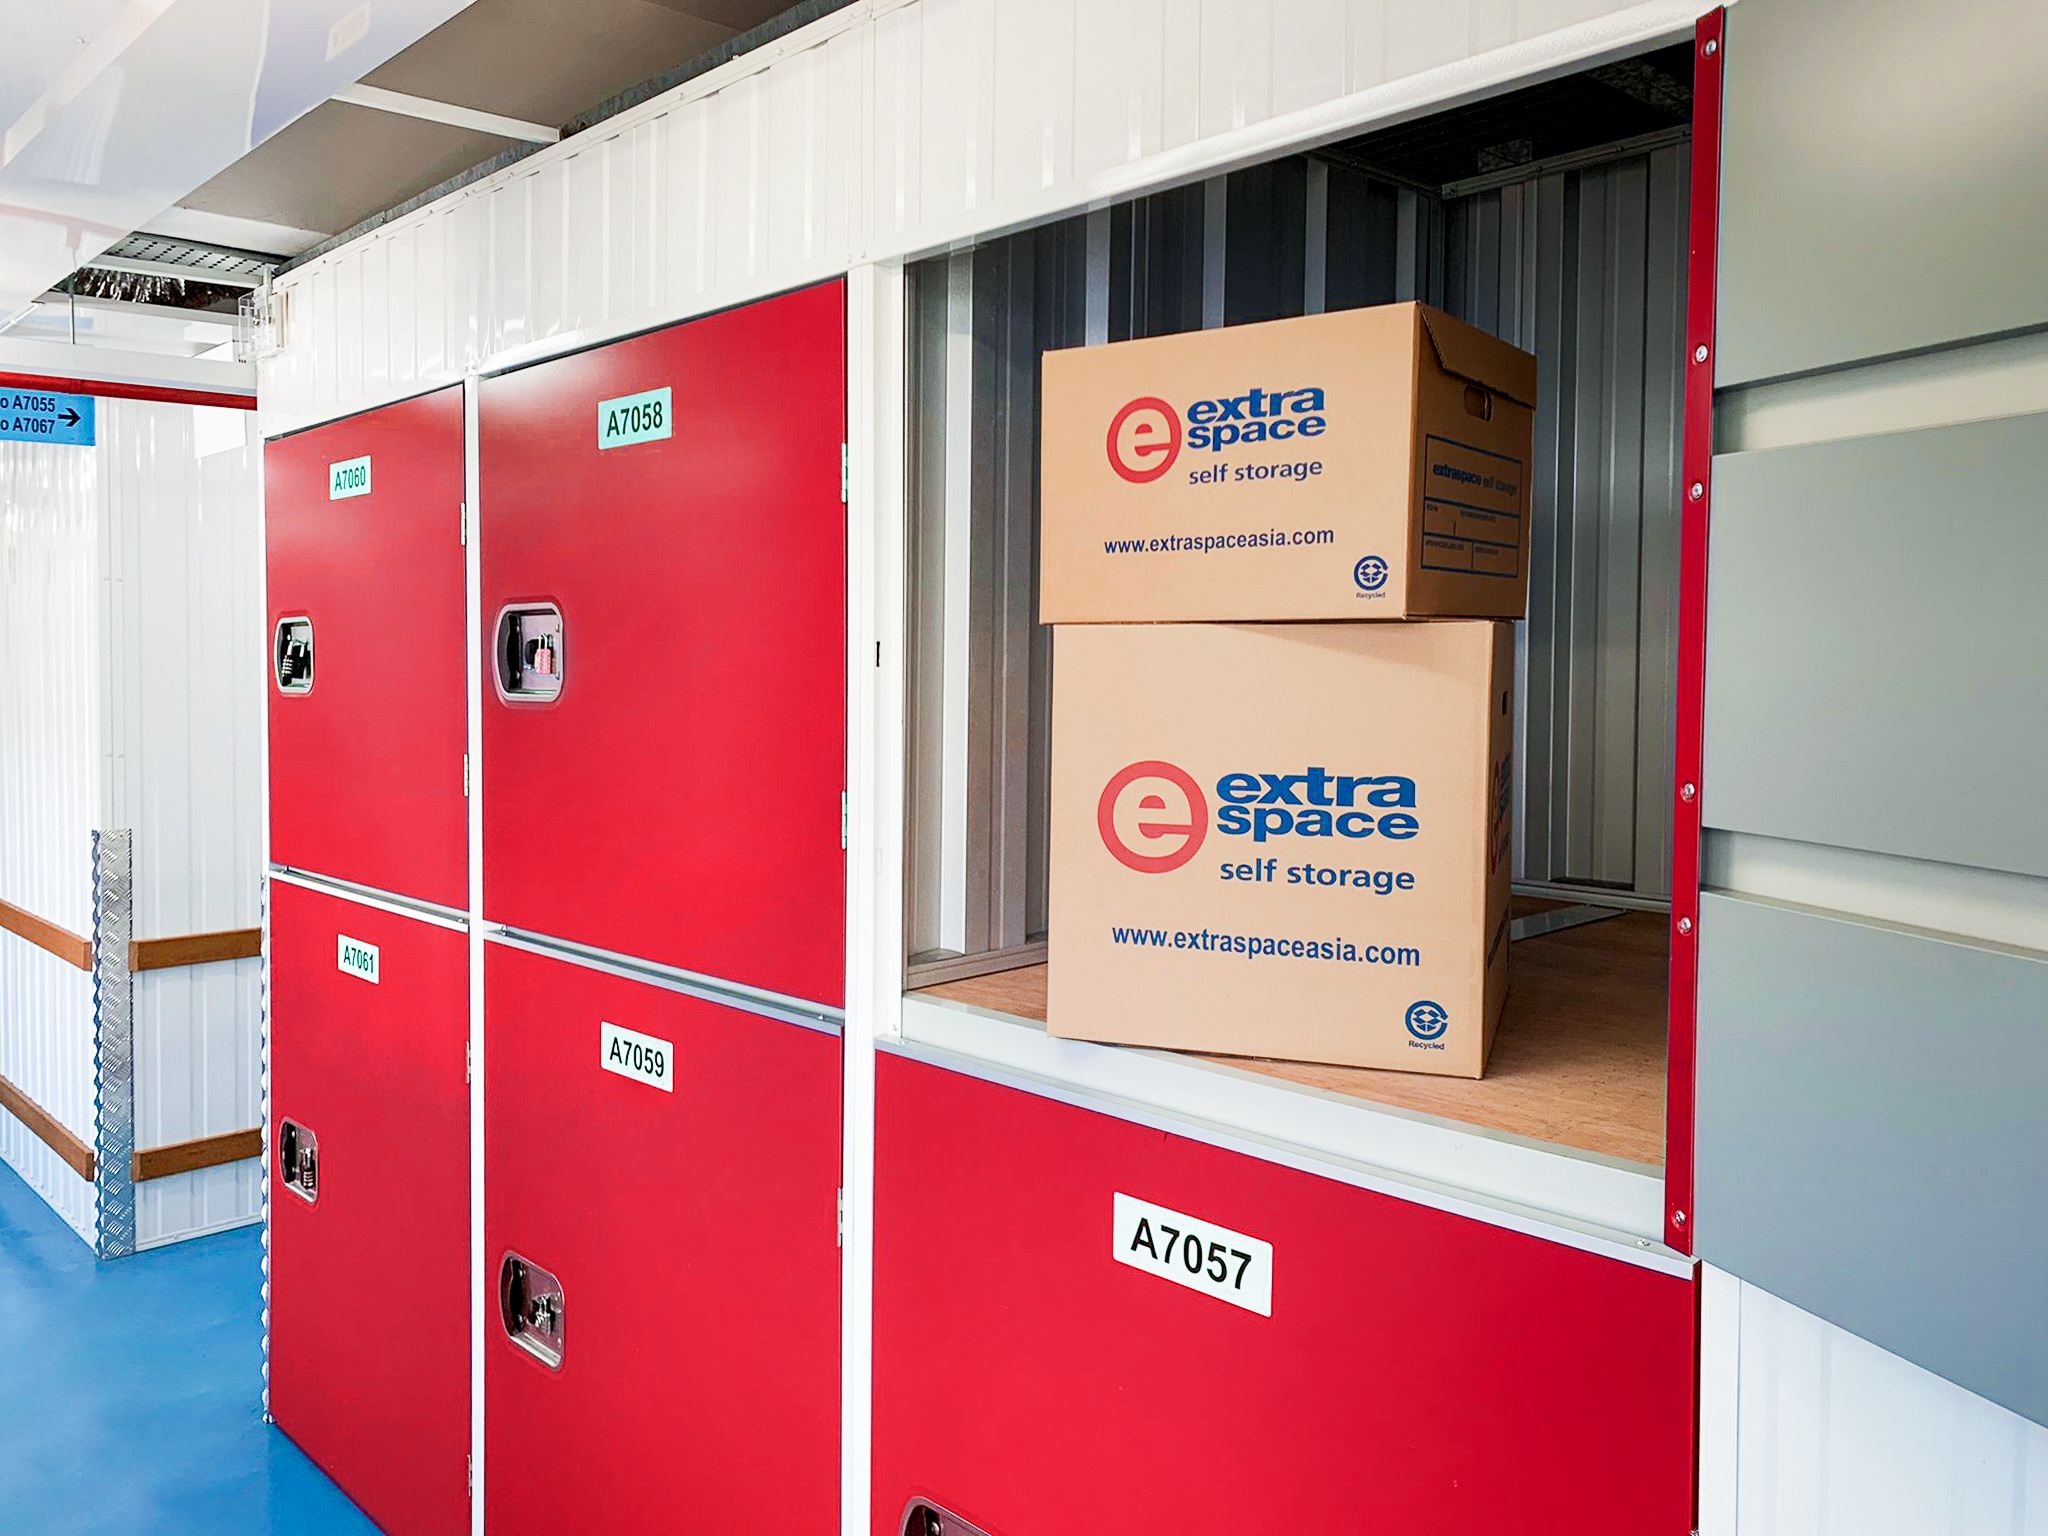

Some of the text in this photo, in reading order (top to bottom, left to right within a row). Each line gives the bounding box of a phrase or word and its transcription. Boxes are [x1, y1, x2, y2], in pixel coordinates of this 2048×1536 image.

[12, 395, 55, 412] A7055
[607, 401, 663, 437] A7058
[1187, 387, 1325, 425] extra
[12, 417, 55, 434] A7067
[1187, 415, 1327, 452] space
[334, 466, 366, 491] A7060
[1189, 461, 1323, 485] self storage
[1433, 463, 1482, 486] extraspace
[1104, 529, 1334, 554] www.extraspaceasia.com
[1355, 592, 1386, 600] Recycled
[1216, 767, 1417, 808] extra
[1216, 804, 1420, 843] space
[1220, 858, 1416, 896] self storage
[343, 945, 374, 974] A7061
[1111, 927, 1420, 966] www.extraspaceasia.com
[610, 1036, 665, 1078] A7059
[1408, 1040, 1445, 1050] Recycled
[1130, 1217, 1252, 1290] A7057
